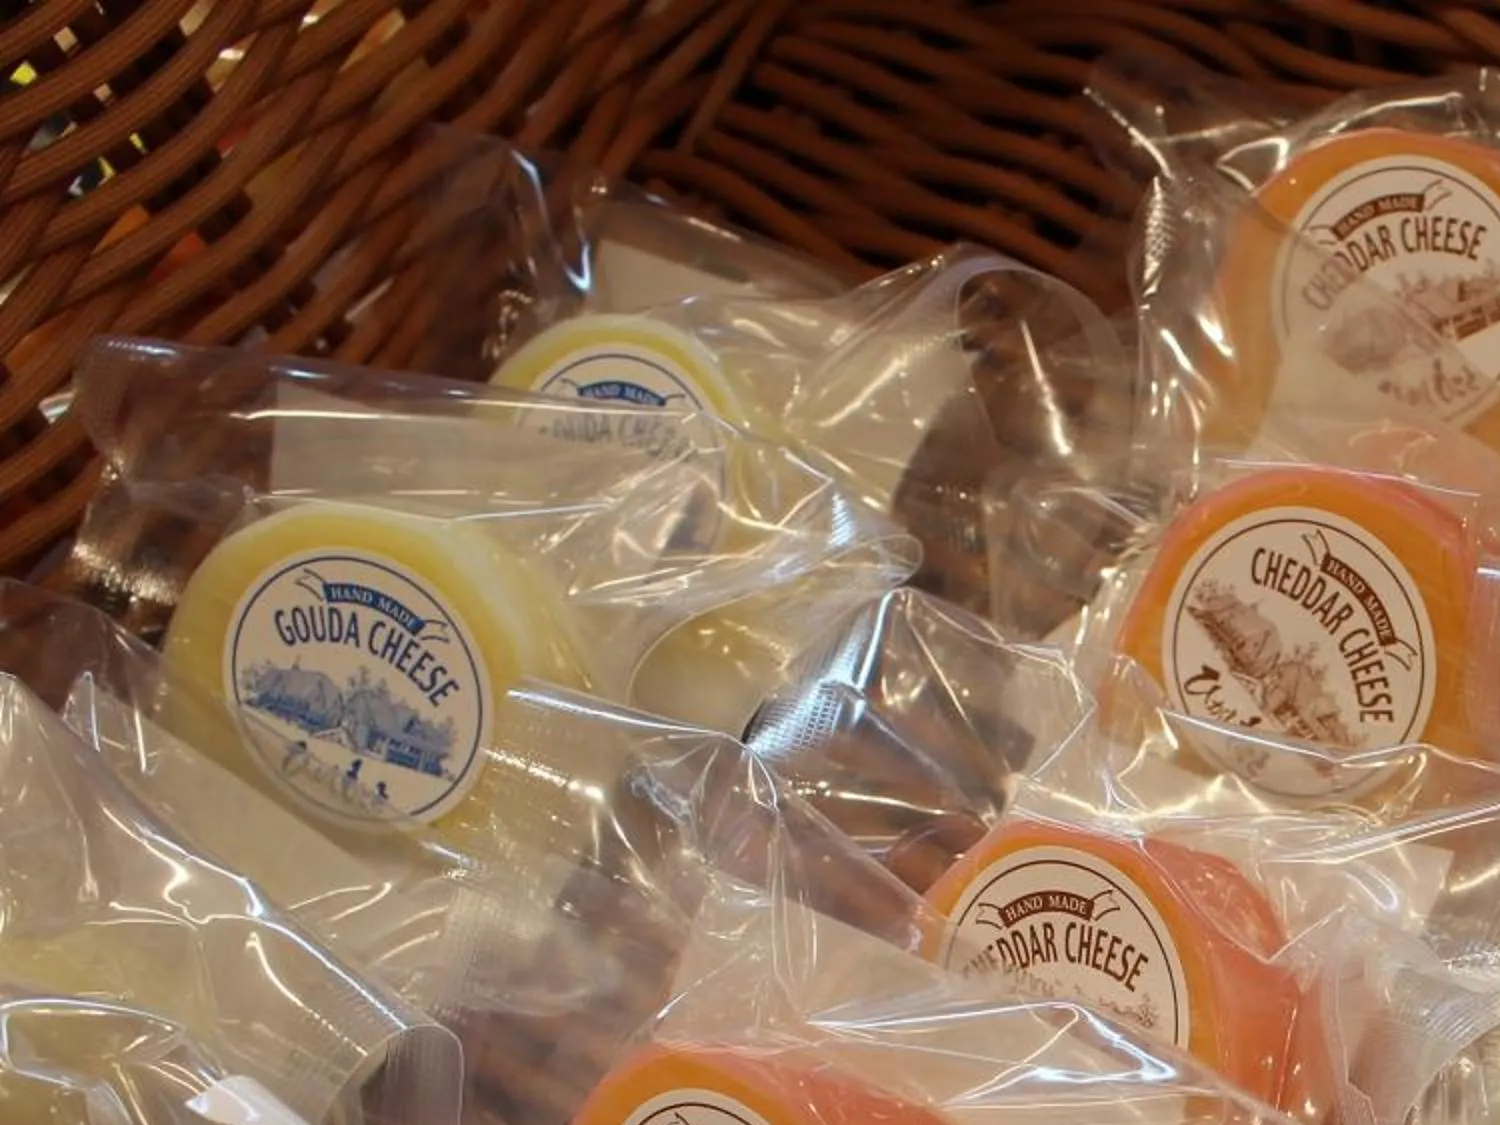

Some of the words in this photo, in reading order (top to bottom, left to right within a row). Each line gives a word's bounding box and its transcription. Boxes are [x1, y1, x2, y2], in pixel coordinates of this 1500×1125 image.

[1302, 223, 1396, 311] CHEDDAR
[1401, 215, 1487, 261] CHEESE
[330, 585, 374, 604] HAND
[376, 597, 417, 631] MADE
[1251, 546, 1356, 636] CHEDDAR
[1338, 627, 1395, 724] CHEESE
[1326, 557, 1367, 597] HAND
[1366, 598, 1392, 644] MADE
[274, 604, 361, 649] GOUDA
[367, 620, 461, 708] CHEESE
[1005, 895, 1043, 921] HAND
[1048, 893, 1088, 916] MADE
[1064, 921, 1150, 993] CHEESE
